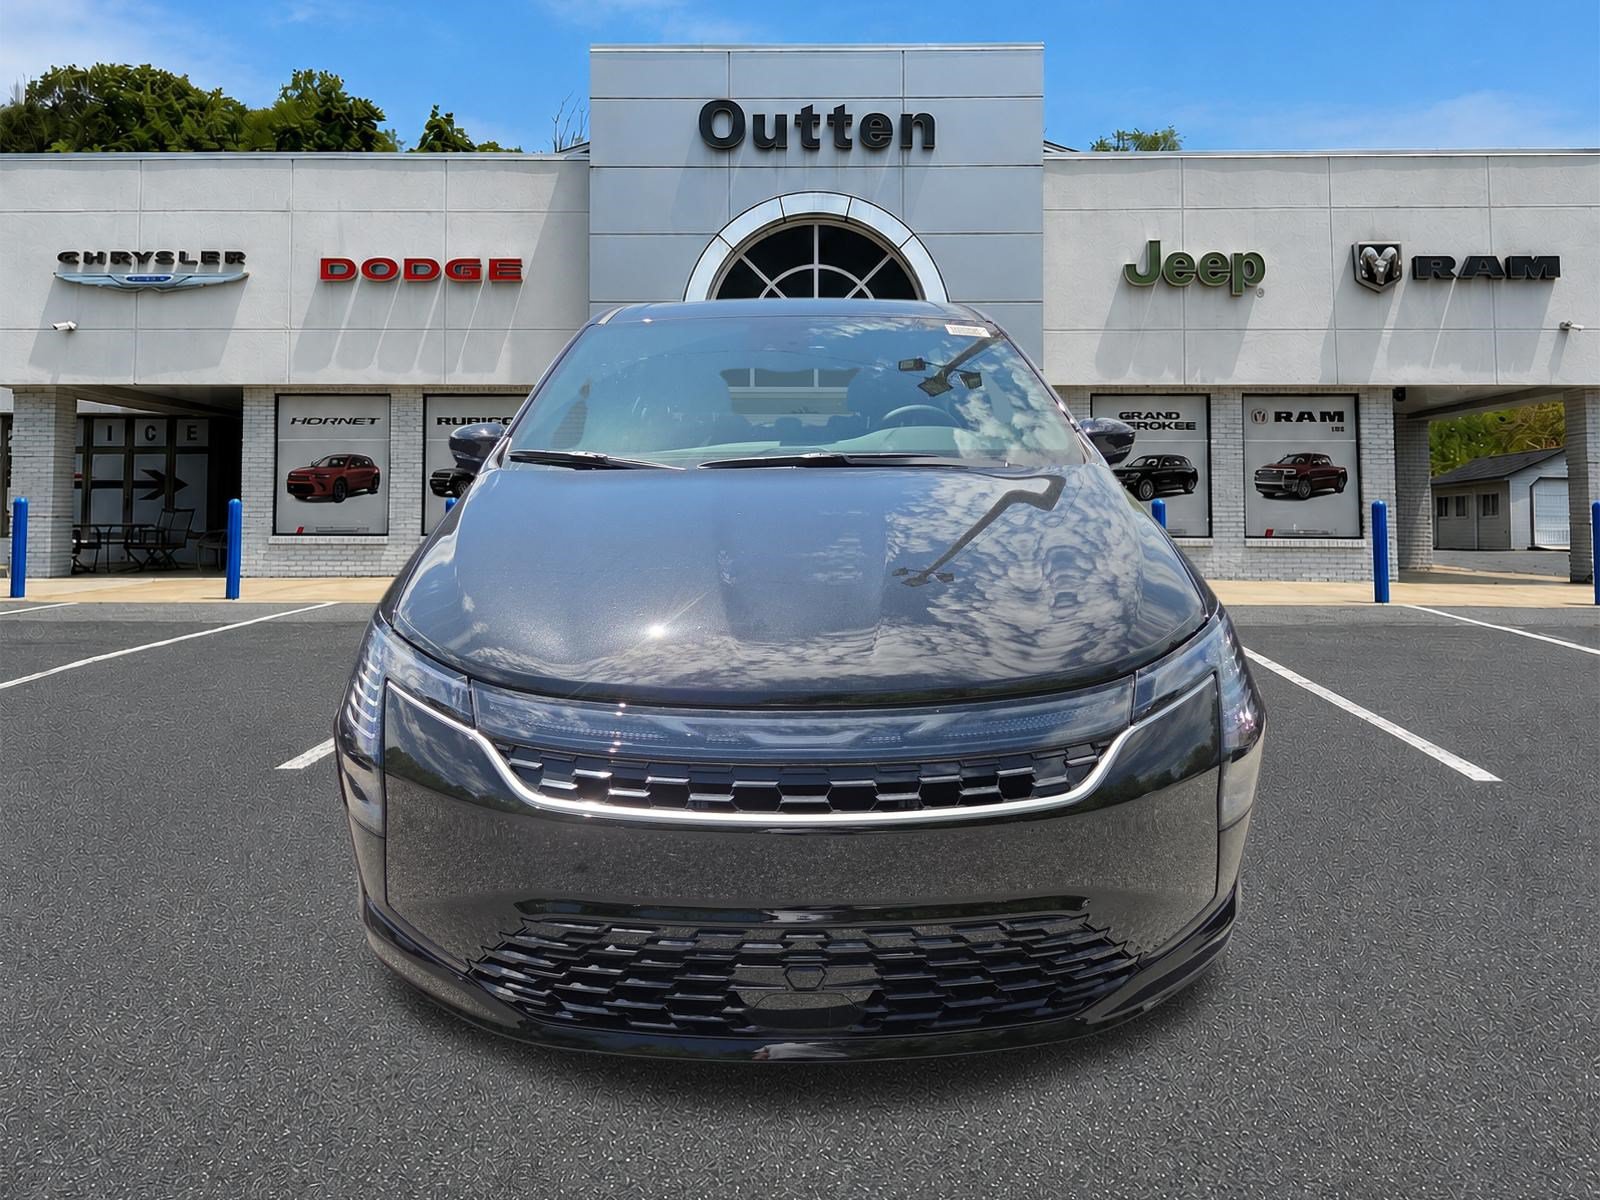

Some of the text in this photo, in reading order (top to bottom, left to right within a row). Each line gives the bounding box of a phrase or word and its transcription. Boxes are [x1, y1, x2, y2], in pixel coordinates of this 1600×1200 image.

[699, 99, 936, 150] Outten
[57, 250, 247, 265] CHRYSLER
[320, 257, 523, 283] DODGE
[1123, 239, 1266, 296] Jeep
[1411, 255, 1560, 280] RAM
[290, 417, 381, 425] HORNET
[436, 416, 513, 425] RUBICO
[1118, 411, 1180, 420] GRAND
[1274, 411, 1344, 422] RAM
[1126, 421, 1197, 430] EROKEE
